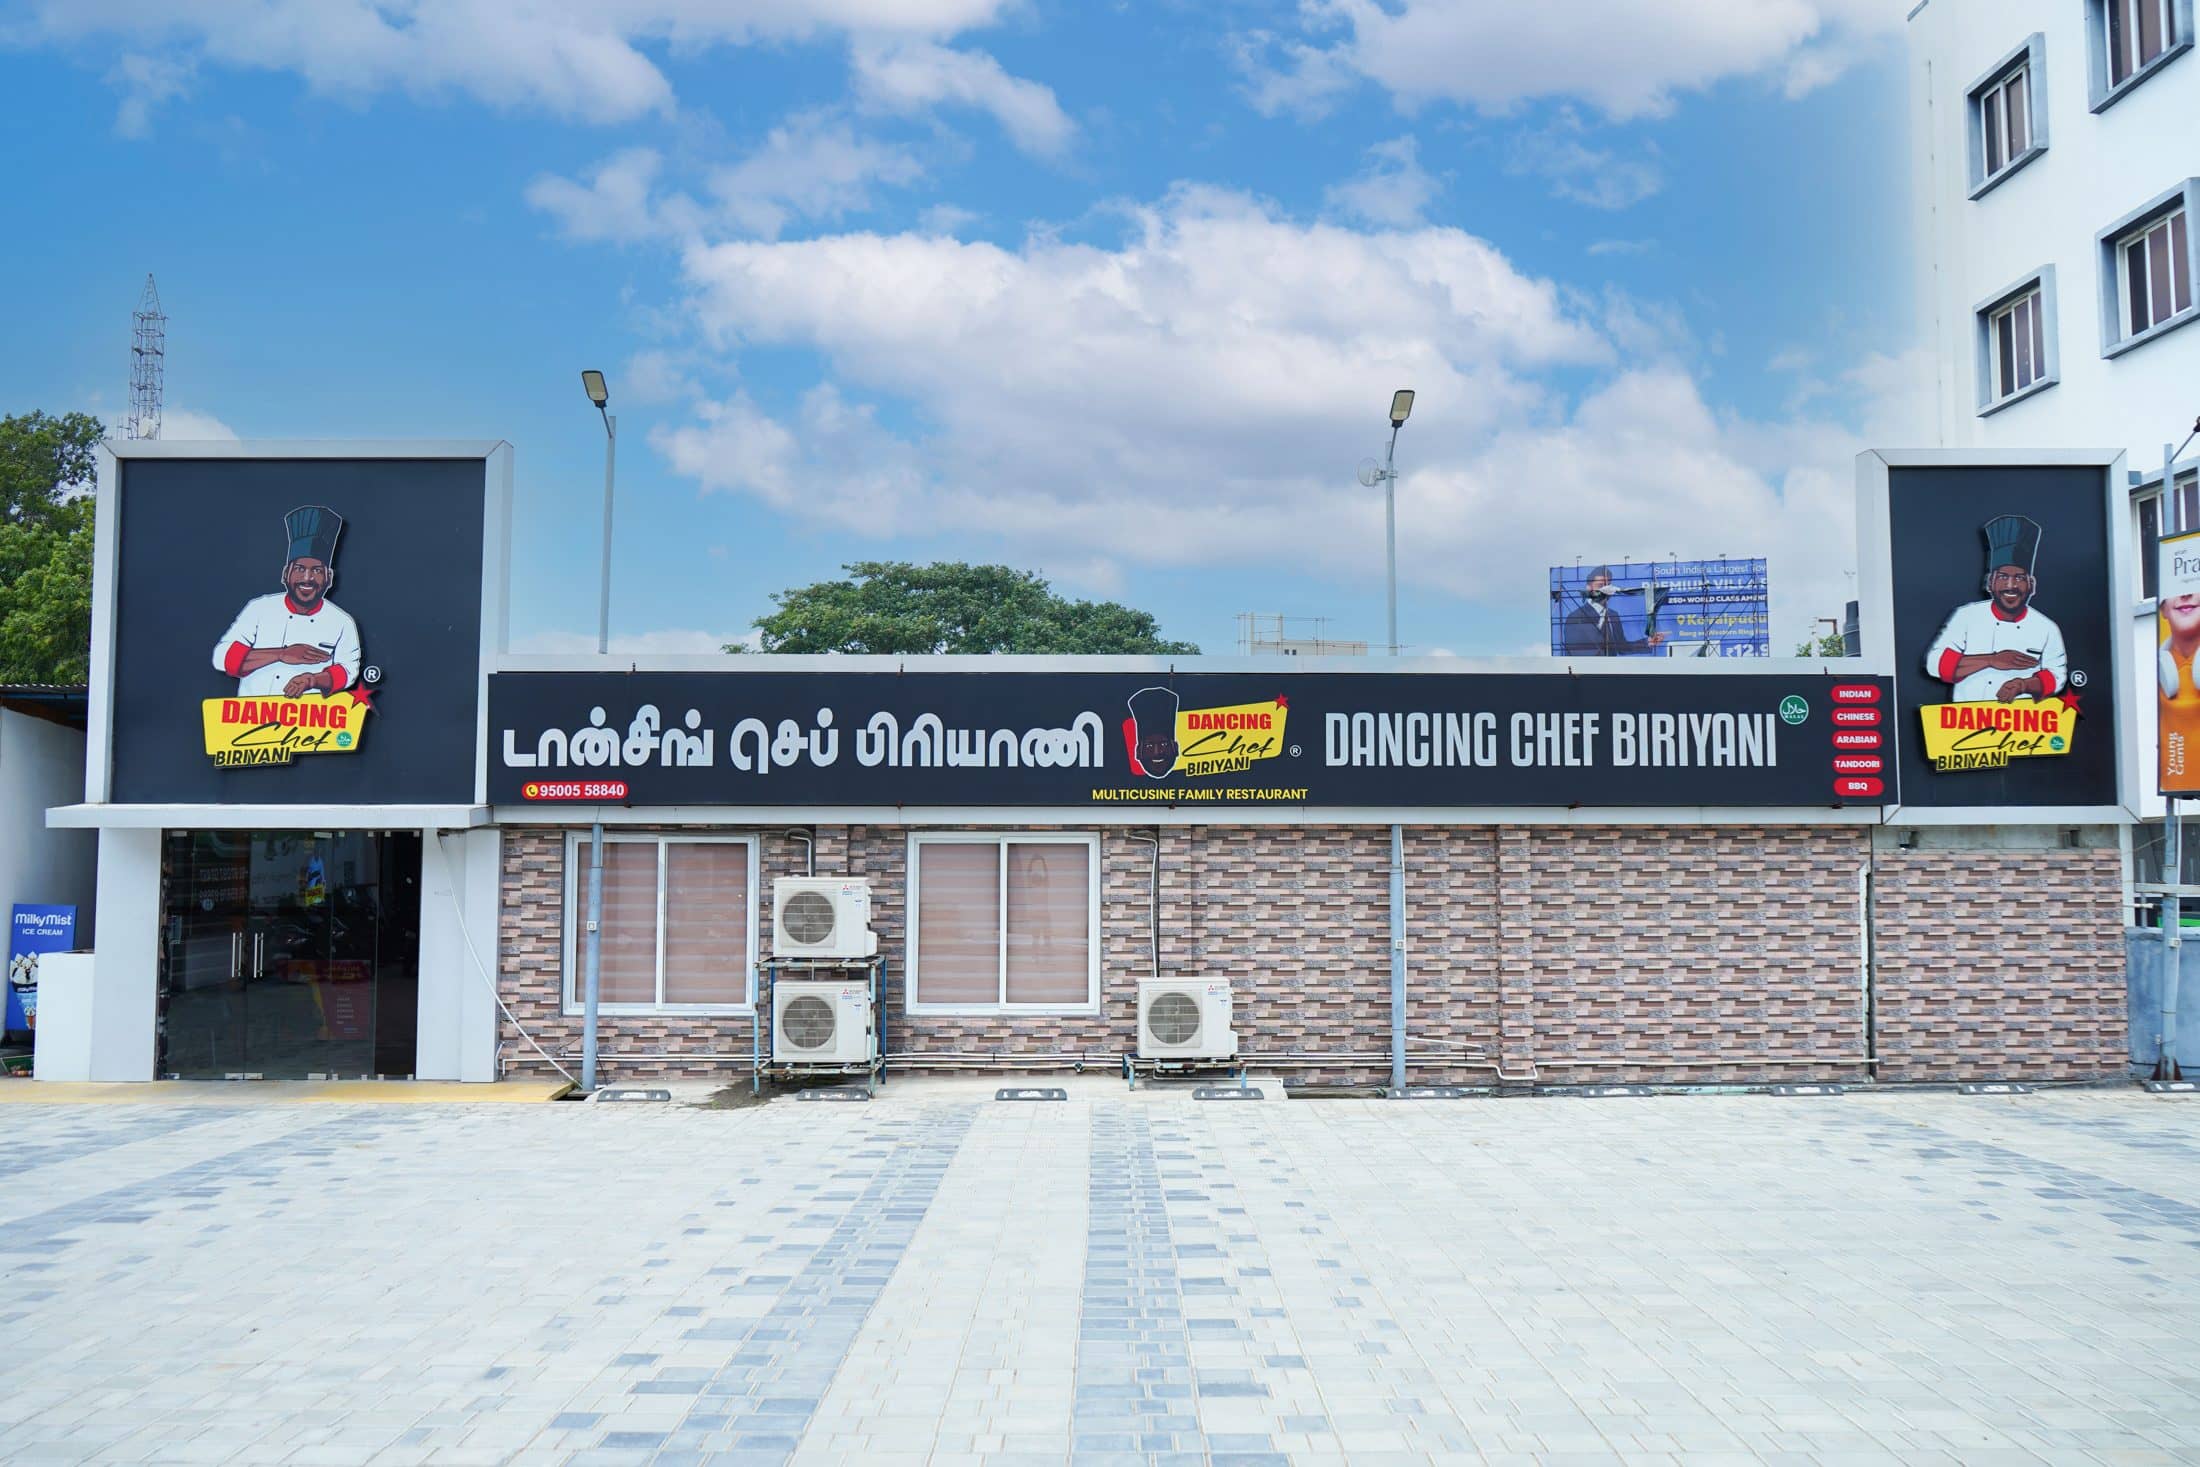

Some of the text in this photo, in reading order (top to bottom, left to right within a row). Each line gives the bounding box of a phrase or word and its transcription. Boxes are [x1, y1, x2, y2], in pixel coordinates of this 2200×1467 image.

[1839, 690, 1871, 698] INDIAN
[222, 700, 347, 729] DANCING
[1188, 713, 1272, 730] DANCING
[1836, 712, 1875, 721] CHINESE
[1940, 706, 2058, 733] DANCING
[231, 721, 332, 751] Chef
[503, 704, 1104, 774] டான்சிங் செப் பிரியாணி
[1182, 731, 1274, 757] Chef
[1325, 712, 1777, 767] DANCING CHEF BIRIYANI
[1836, 735, 1877, 743] ARABIAN
[1951, 726, 2045, 755] Chef
[215, 747, 290, 766] BIRIYANI
[1834, 760, 1880, 768] TANDOORI
[1937, 752, 2007, 769] BIRIYANI
[1187, 757, 1250, 776] BIRIYANI
[540, 784, 625, 797] 95005 58840
[1092, 789, 1308, 800] MULTICUSINE FAMILY RESTAURANT
[1848, 782, 1868, 791] BBQ
